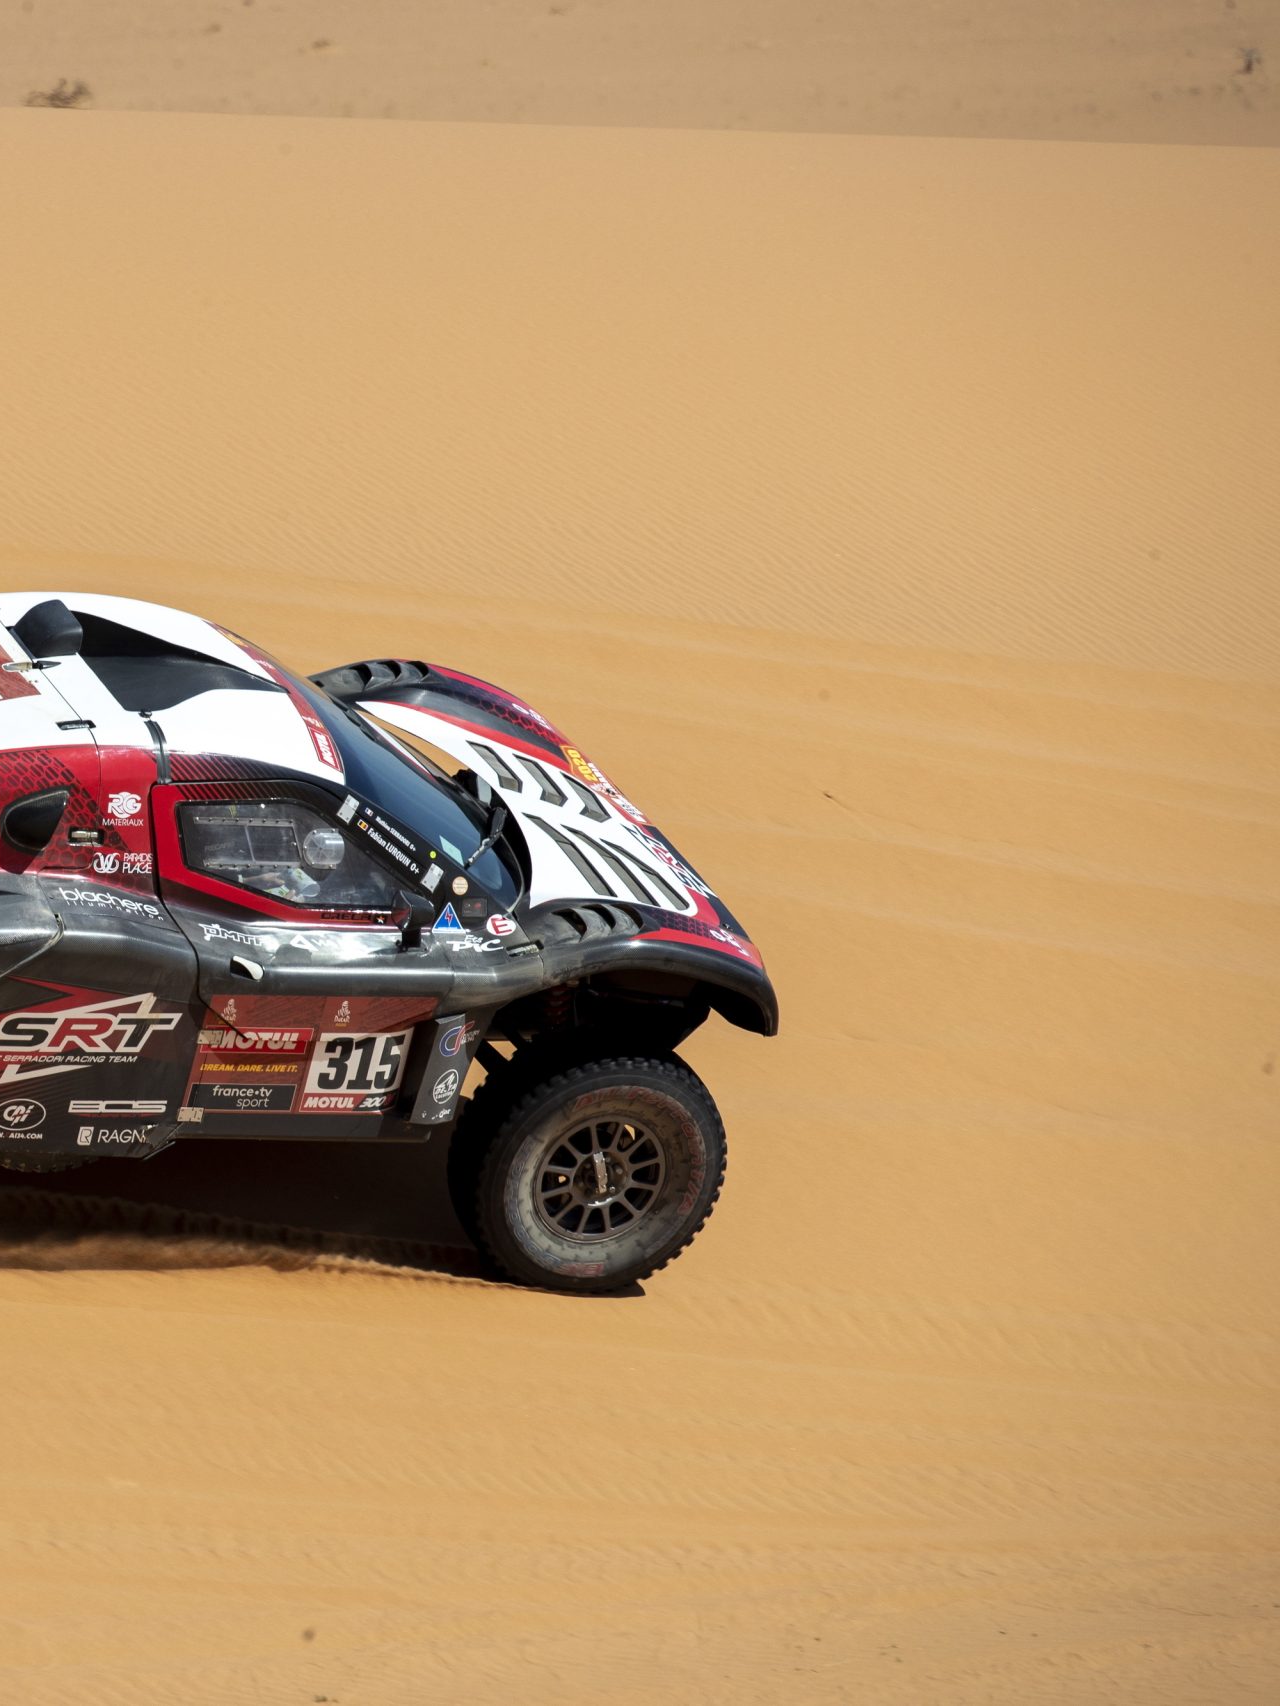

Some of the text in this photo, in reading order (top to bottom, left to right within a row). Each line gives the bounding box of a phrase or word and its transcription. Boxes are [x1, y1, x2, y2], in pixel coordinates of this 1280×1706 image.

[102, 818, 144, 827] MATERIAUX
[367, 827, 387, 848] Fabian
[385, 842, 412, 867] LURQUIN
[123, 853, 154, 861] PARADIS
[122, 862, 153, 874] PLAGE
[59, 887, 160, 916] blachere
[212, 1030, 300, 1050] MOTUL
[3, 1055, 138, 1063] SERRADORI RACING TEAM
[317, 1034, 406, 1090] 315
[200, 1064, 235, 1072] DREAM.
[237, 1064, 264, 1072] DARE.
[265, 1064, 288, 1072] LIVE
[236, 1098, 270, 1110] sport
[303, 1096, 355, 1108] MOTUL
